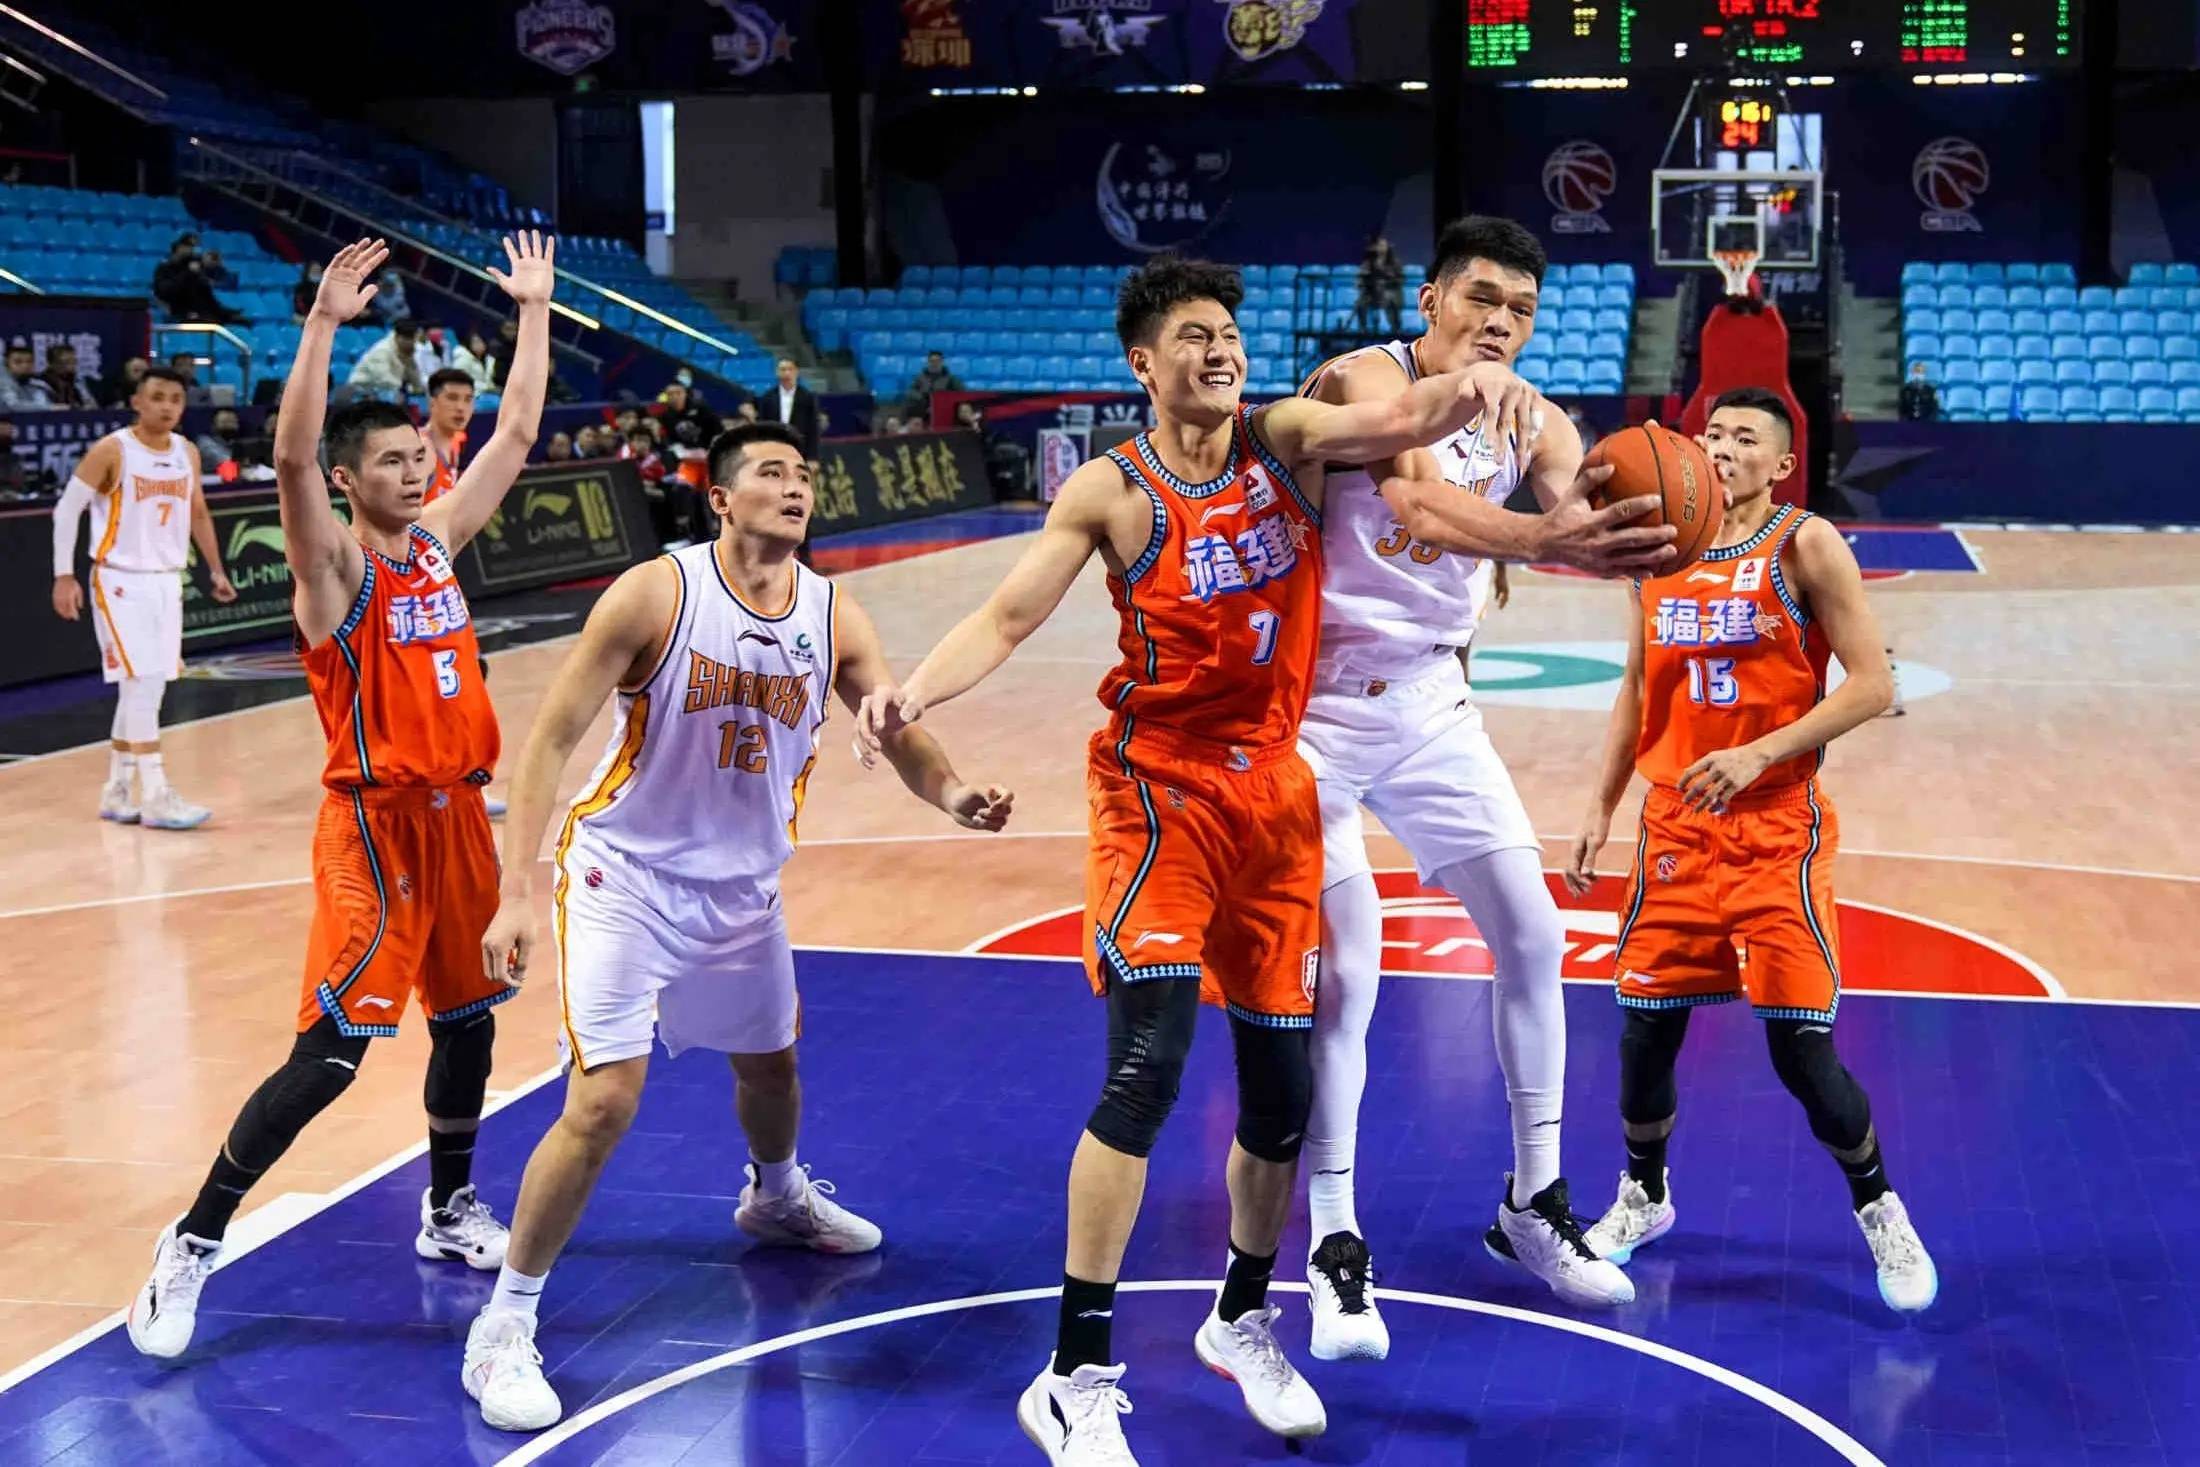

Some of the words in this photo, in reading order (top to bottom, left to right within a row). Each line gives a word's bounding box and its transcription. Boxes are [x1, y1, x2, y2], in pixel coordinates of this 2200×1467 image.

[1723, 123, 1758, 146] 24
[1551, 212, 1613, 233] CBA
[1920, 210, 1983, 232] CBA
[157, 502, 173, 527] 7
[1185, 512, 1298, 603] 福建
[389, 585, 469, 643] 福建
[1248, 609, 1281, 665] 7
[1655, 597, 1760, 647] 福建
[431, 649, 462, 699] 5
[683, 646, 813, 731] SHANXI
[1686, 657, 1740, 705] 15
[718, 720, 769, 774] 12
